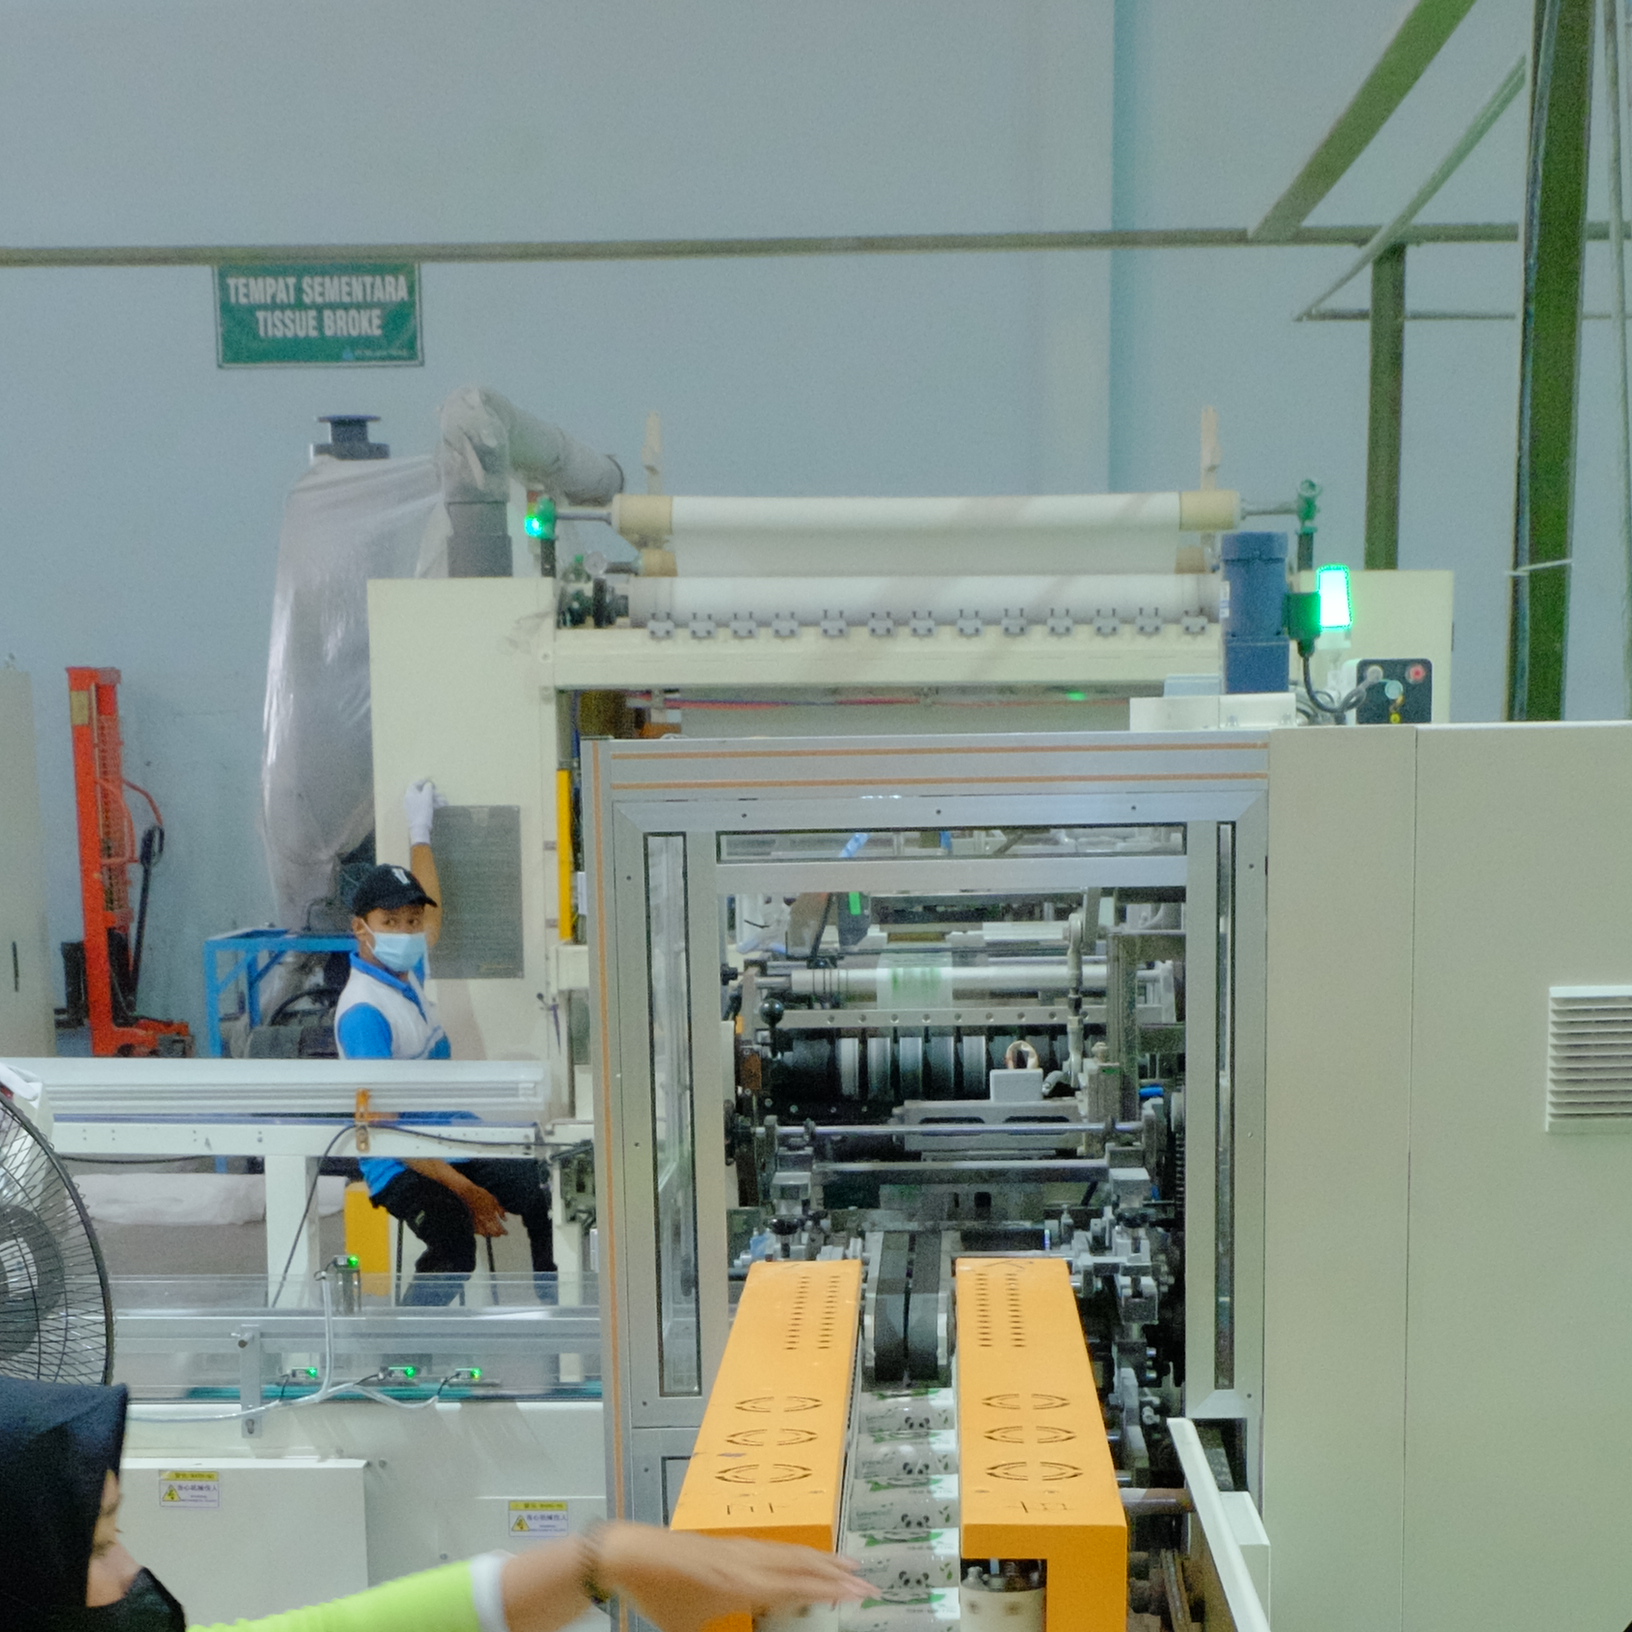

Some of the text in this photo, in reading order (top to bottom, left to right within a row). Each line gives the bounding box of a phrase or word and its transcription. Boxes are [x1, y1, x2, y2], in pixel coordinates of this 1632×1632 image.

[226, 275, 409, 305] TEMPAT SEMENTARA
[256, 309, 383, 338] TISSUE BROKE
